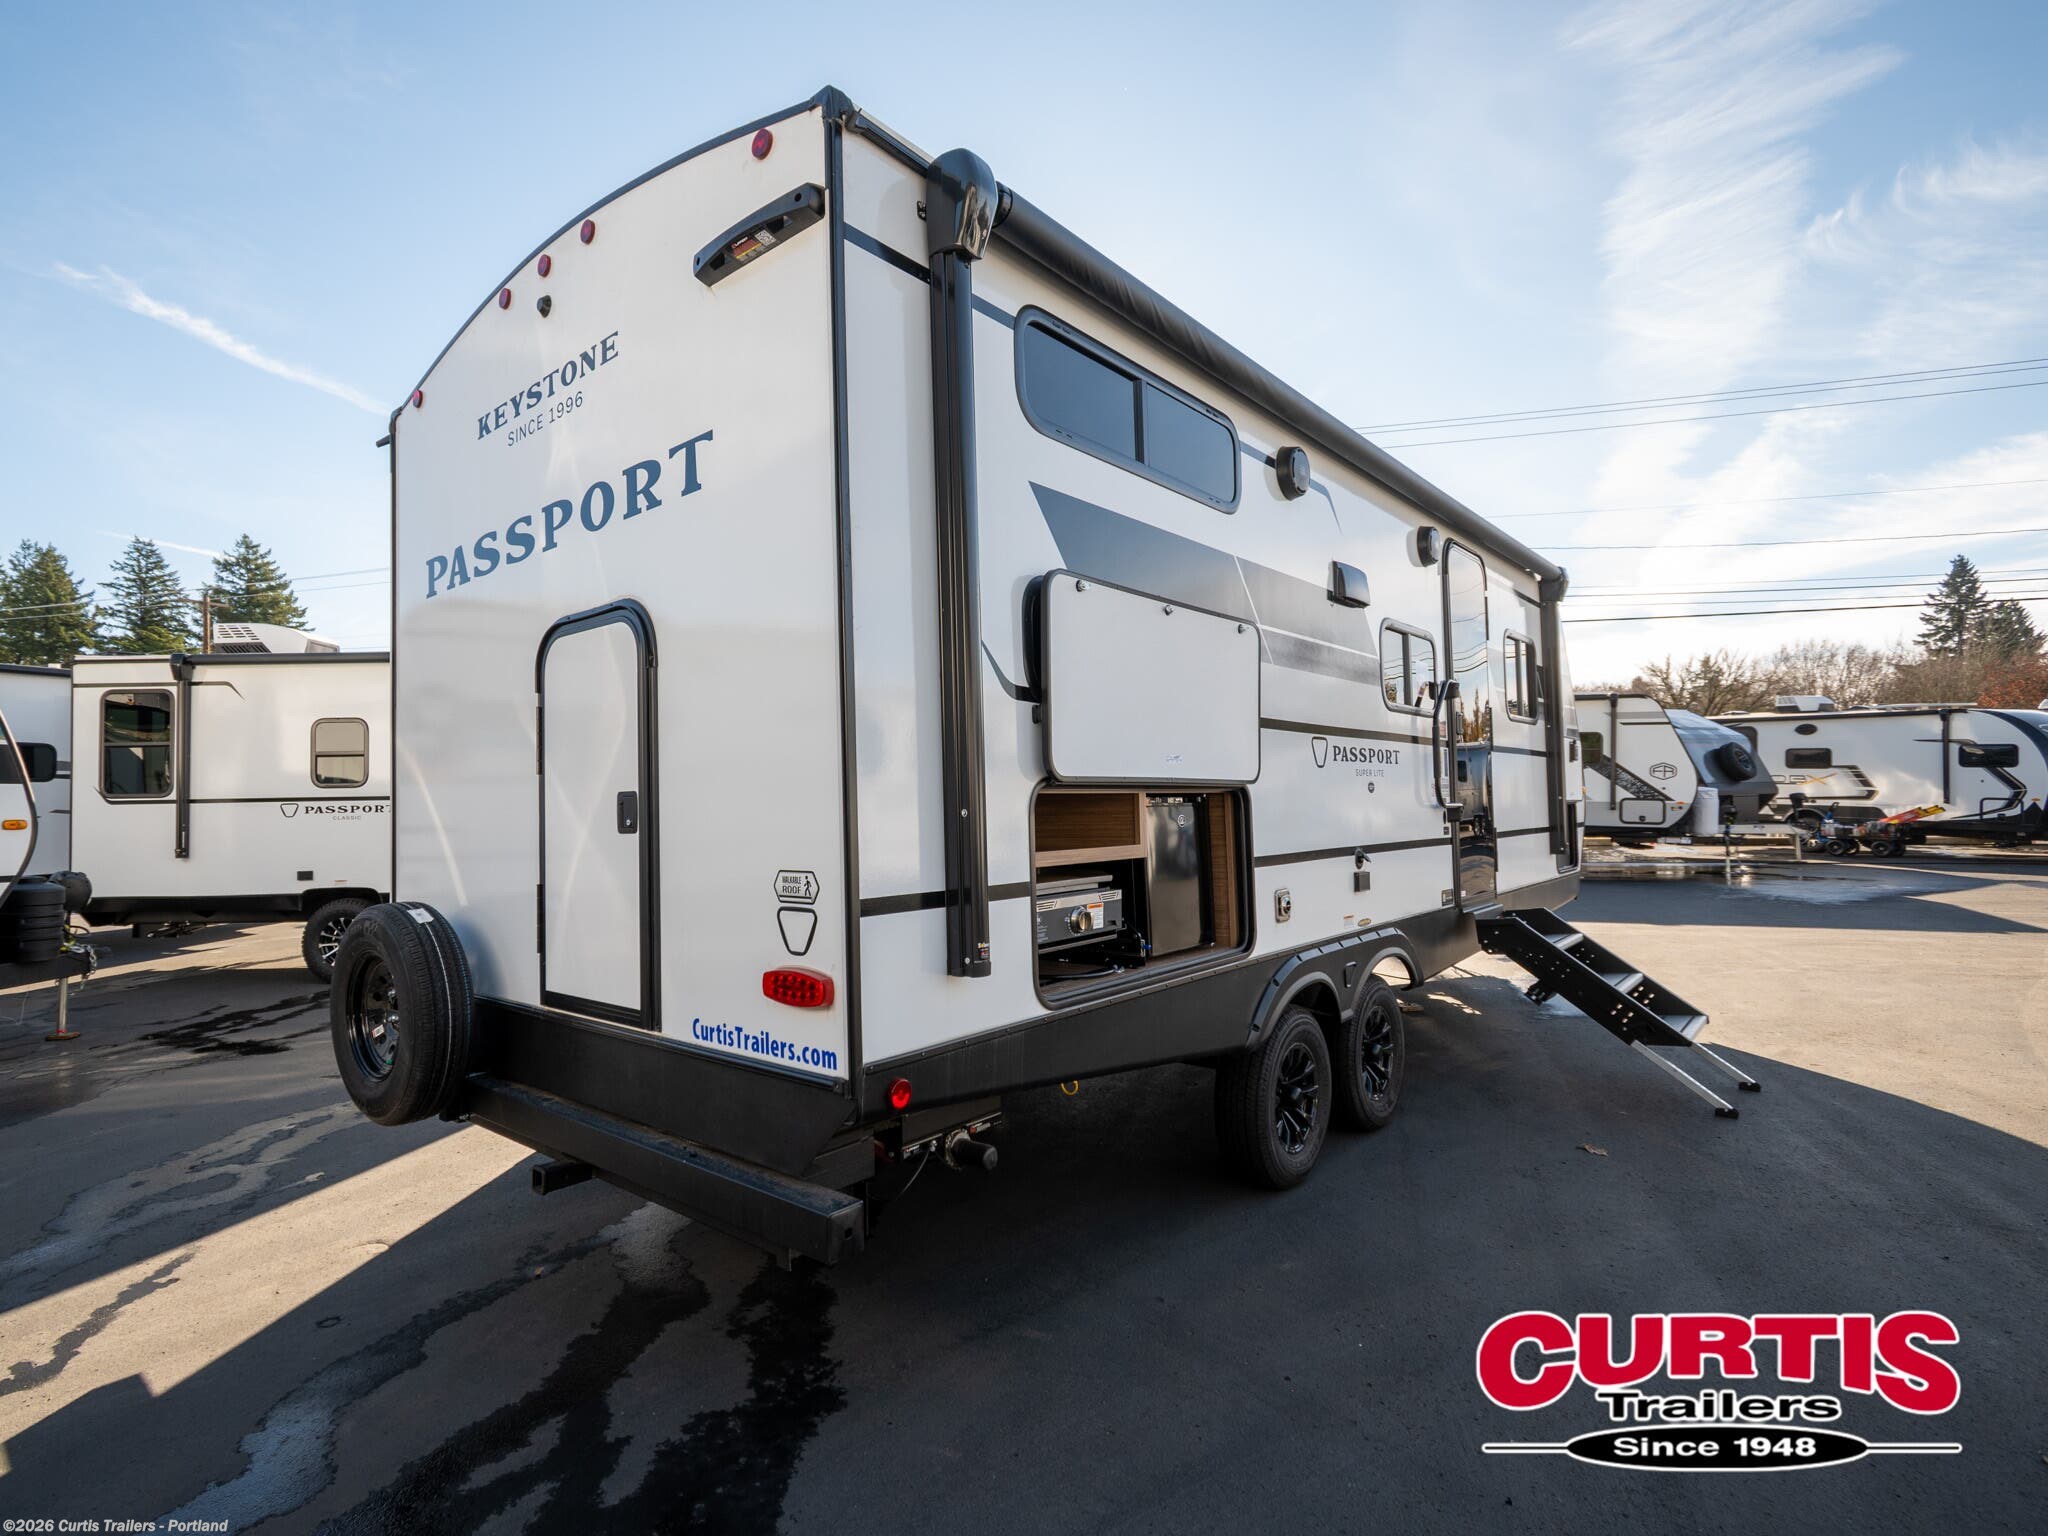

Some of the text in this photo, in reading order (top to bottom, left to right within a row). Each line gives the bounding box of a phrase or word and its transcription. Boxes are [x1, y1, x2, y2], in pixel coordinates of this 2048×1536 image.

[477, 330, 619, 440] KEYSTONE
[507, 391, 583, 447] SINCE 1996
[426, 429, 713, 599] PASSPORT
[1333, 745, 1400, 765] PASSPORT
[1355, 769, 1373, 777] SUPER
[782, 885, 802, 894] ROOF
[692, 1017, 838, 1071] CurtisTrailers.com
